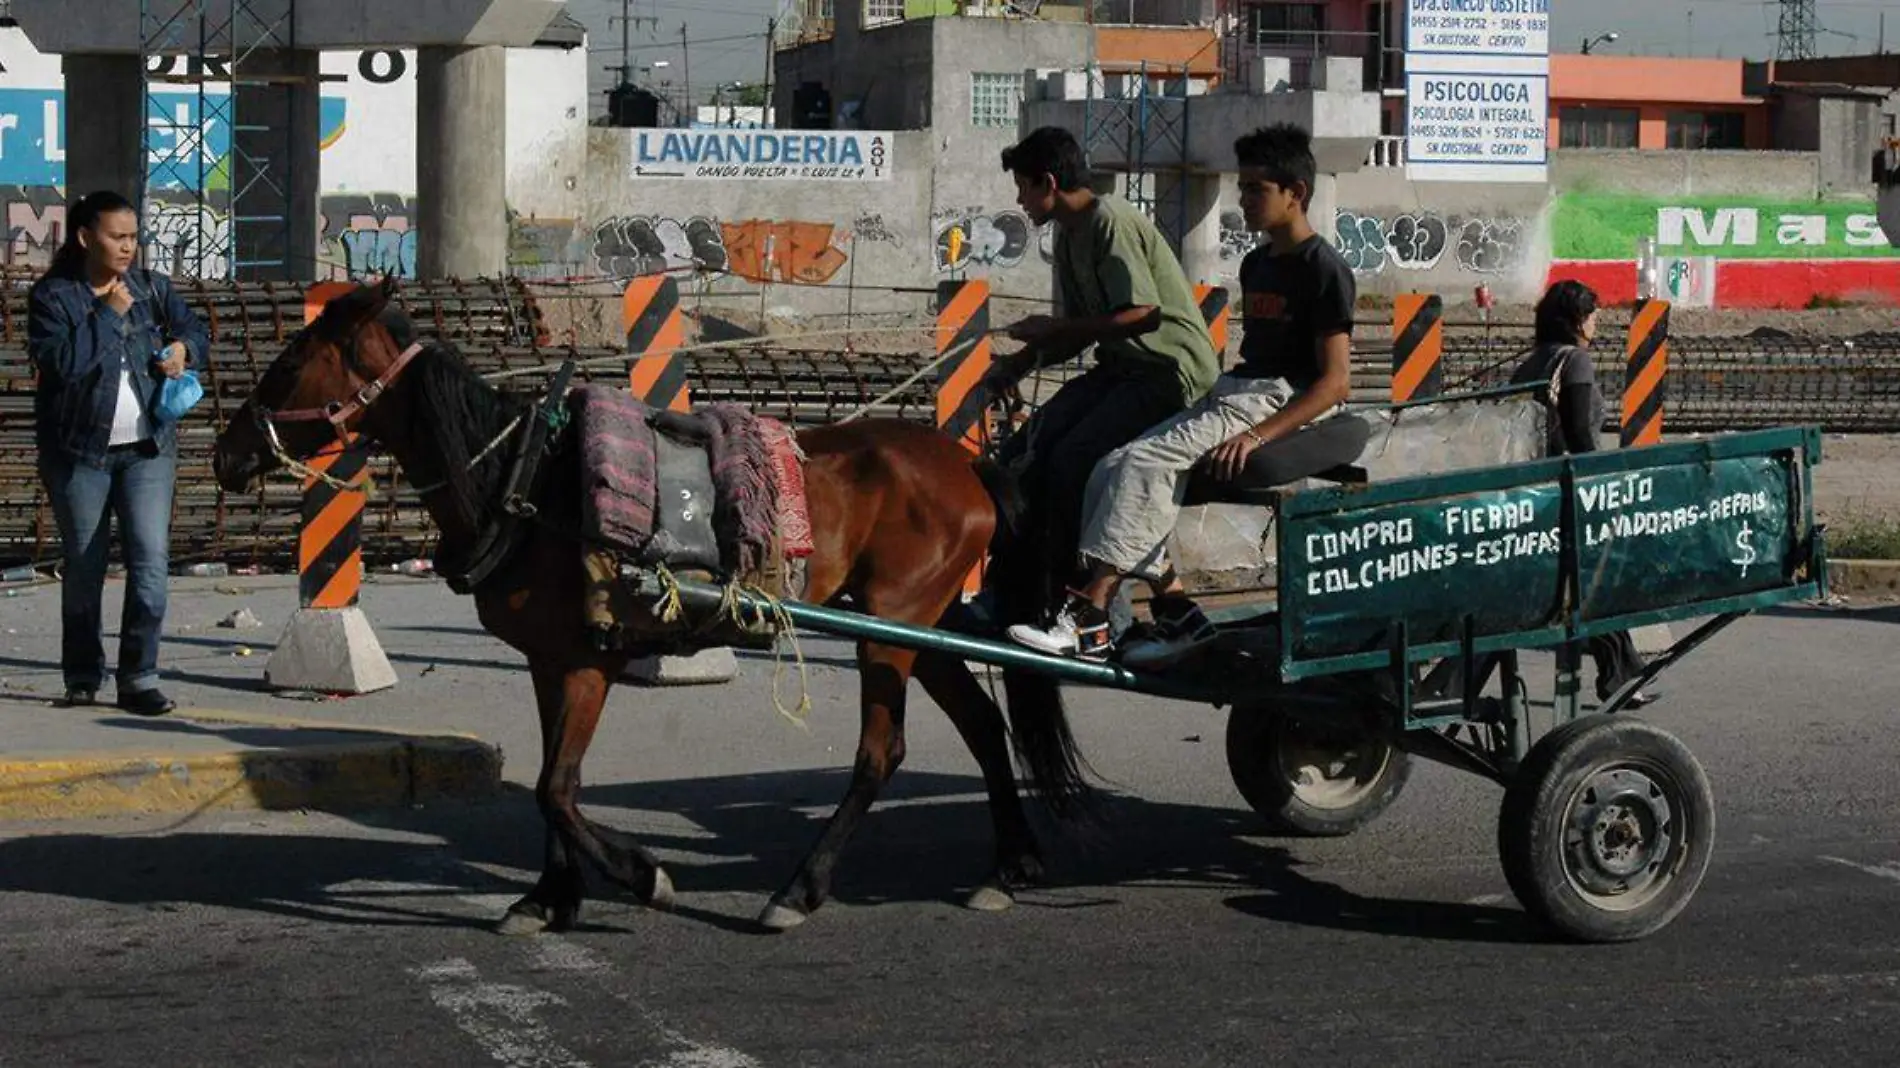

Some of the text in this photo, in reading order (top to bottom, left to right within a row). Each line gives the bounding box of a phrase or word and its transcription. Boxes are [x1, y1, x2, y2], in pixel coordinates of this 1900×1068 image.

[1487, 35, 1526, 47] CENTRO
[1424, 81, 1529, 102] PSICOLOGA
[1412, 106, 1534, 122] PSICOLOGIA INTEGRAL
[638, 132, 863, 163] LAVANDERIA
[1490, 143, 1529, 155] CENTRO
[695, 165, 739, 177] DANDO
[1657, 207, 1889, 246] Mas
[1306, 474, 1654, 563] COMPRO FIERRO VIEJO
[1731, 520, 1757, 579] $
